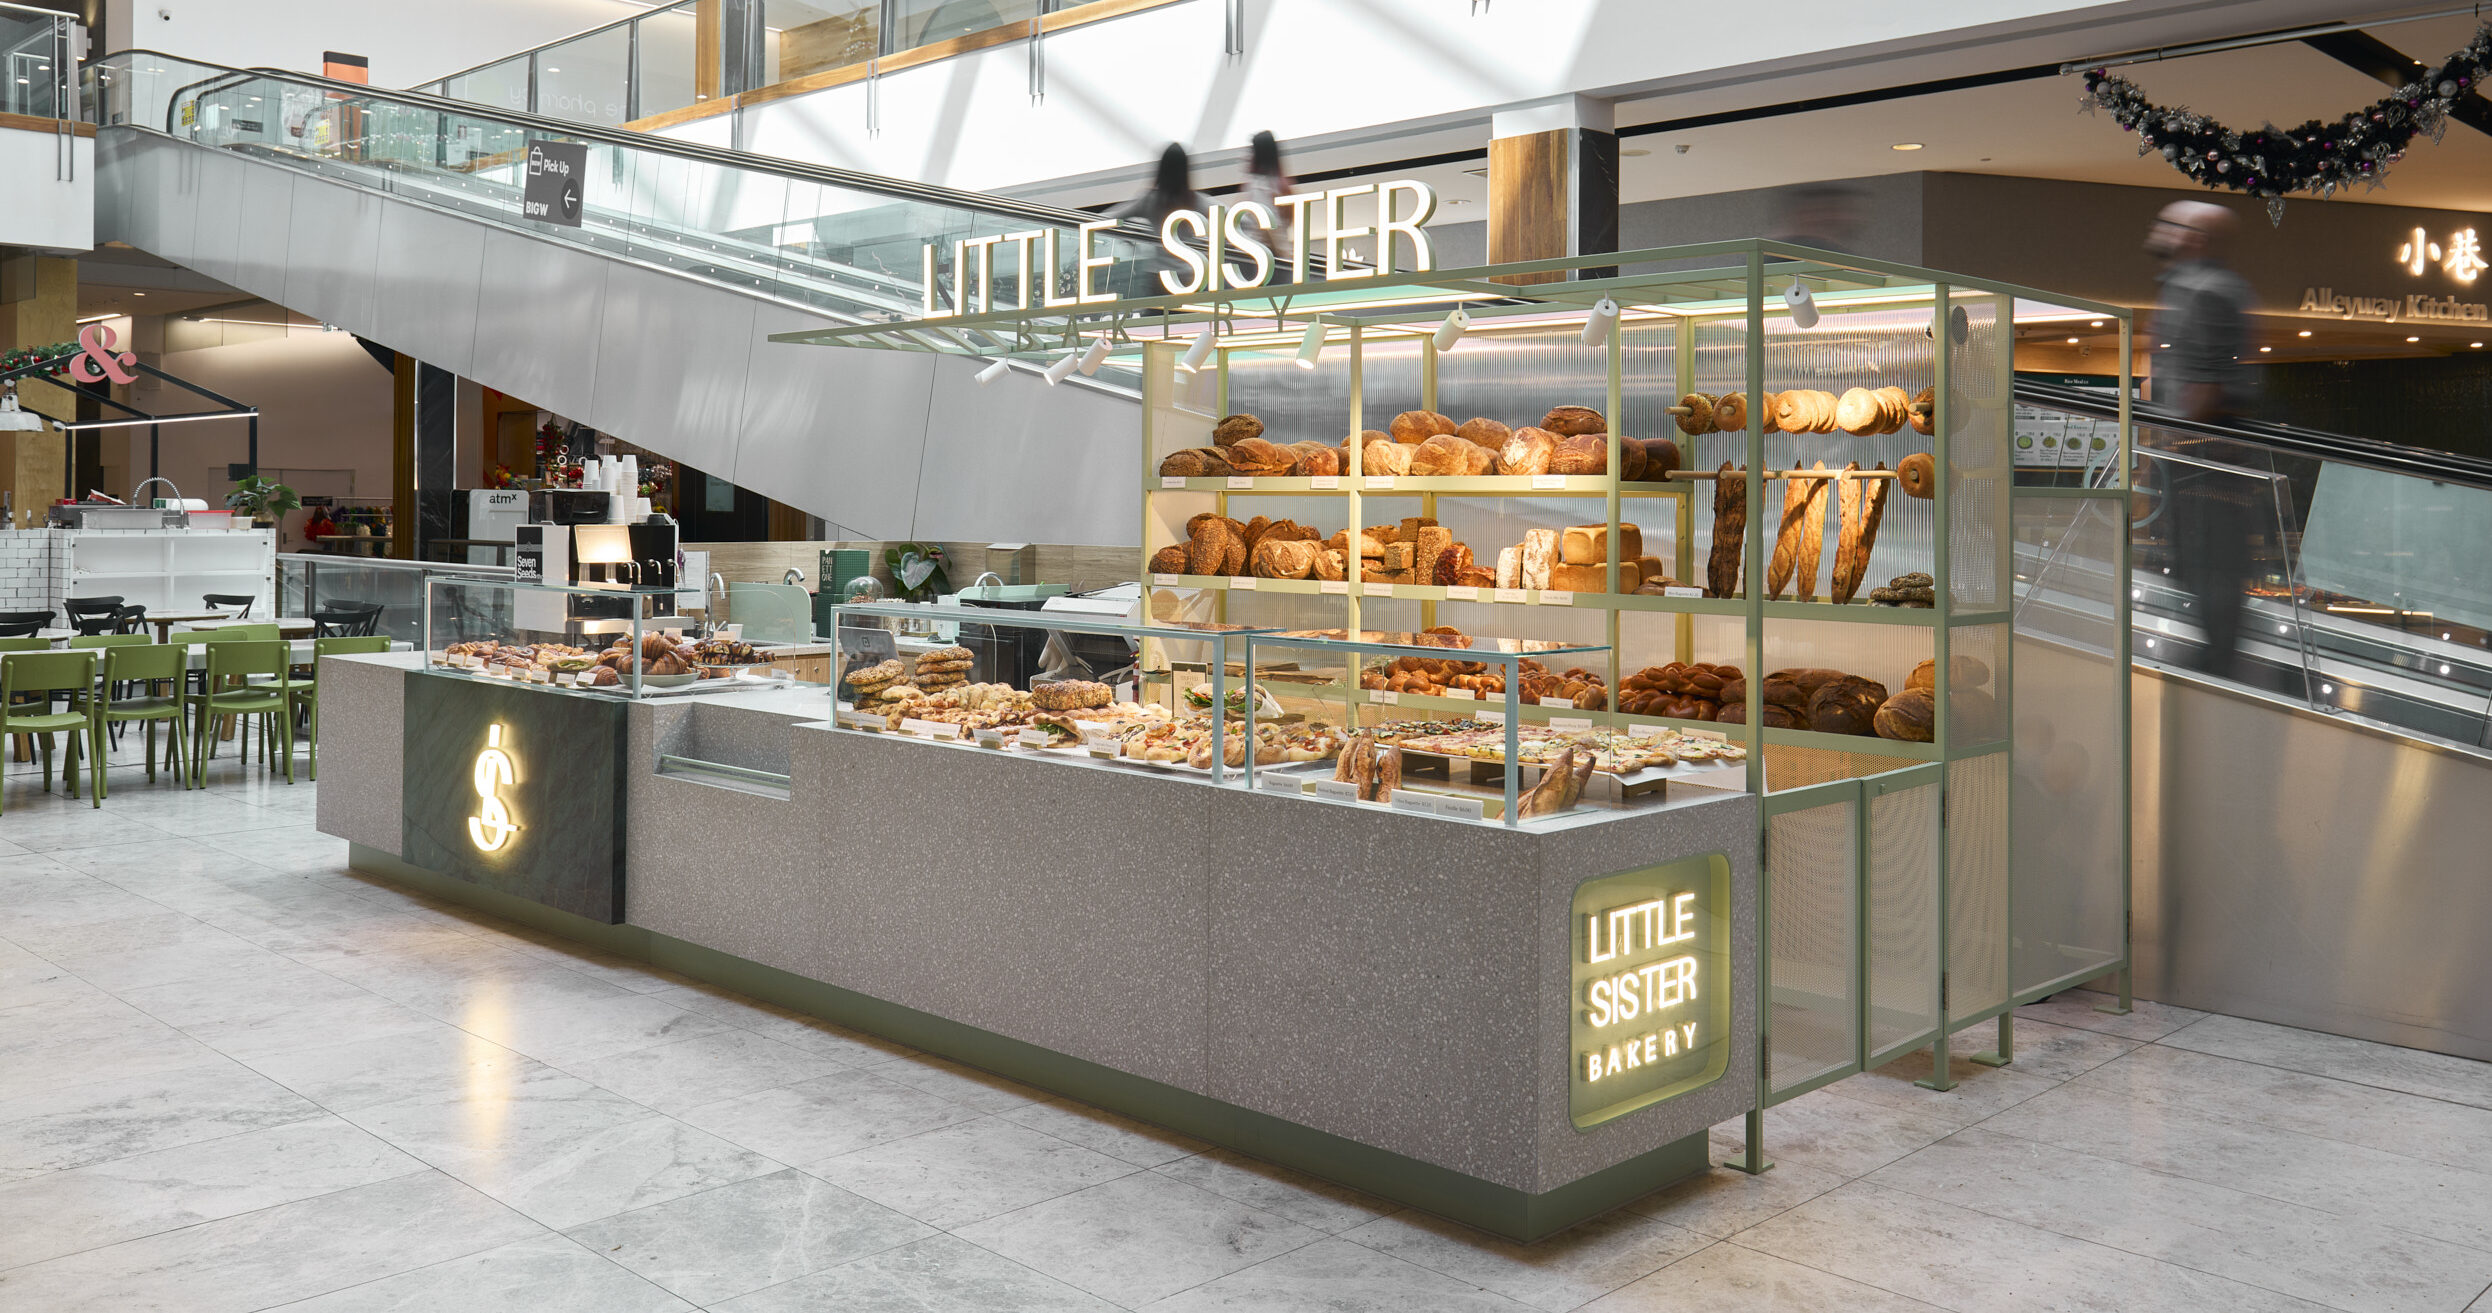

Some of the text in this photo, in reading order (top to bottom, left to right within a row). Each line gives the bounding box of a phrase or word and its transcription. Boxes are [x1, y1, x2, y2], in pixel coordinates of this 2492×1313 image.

[543, 159, 570, 177] Pick Up
[922, 179, 1436, 319] LITTLE SISTER
[2399, 226, 2490, 281] 小巷
[1016, 295, 1293, 353] BAKERY
[2299, 286, 2488, 323] Alleyway Kitchen
[517, 556, 536, 567] Seven
[517, 567, 536, 579] Seeds
[1590, 893, 1695, 964] LITTLE
[1590, 956, 1698, 1028] SISTER
[1589, 1022, 1697, 1083] BAKERY
